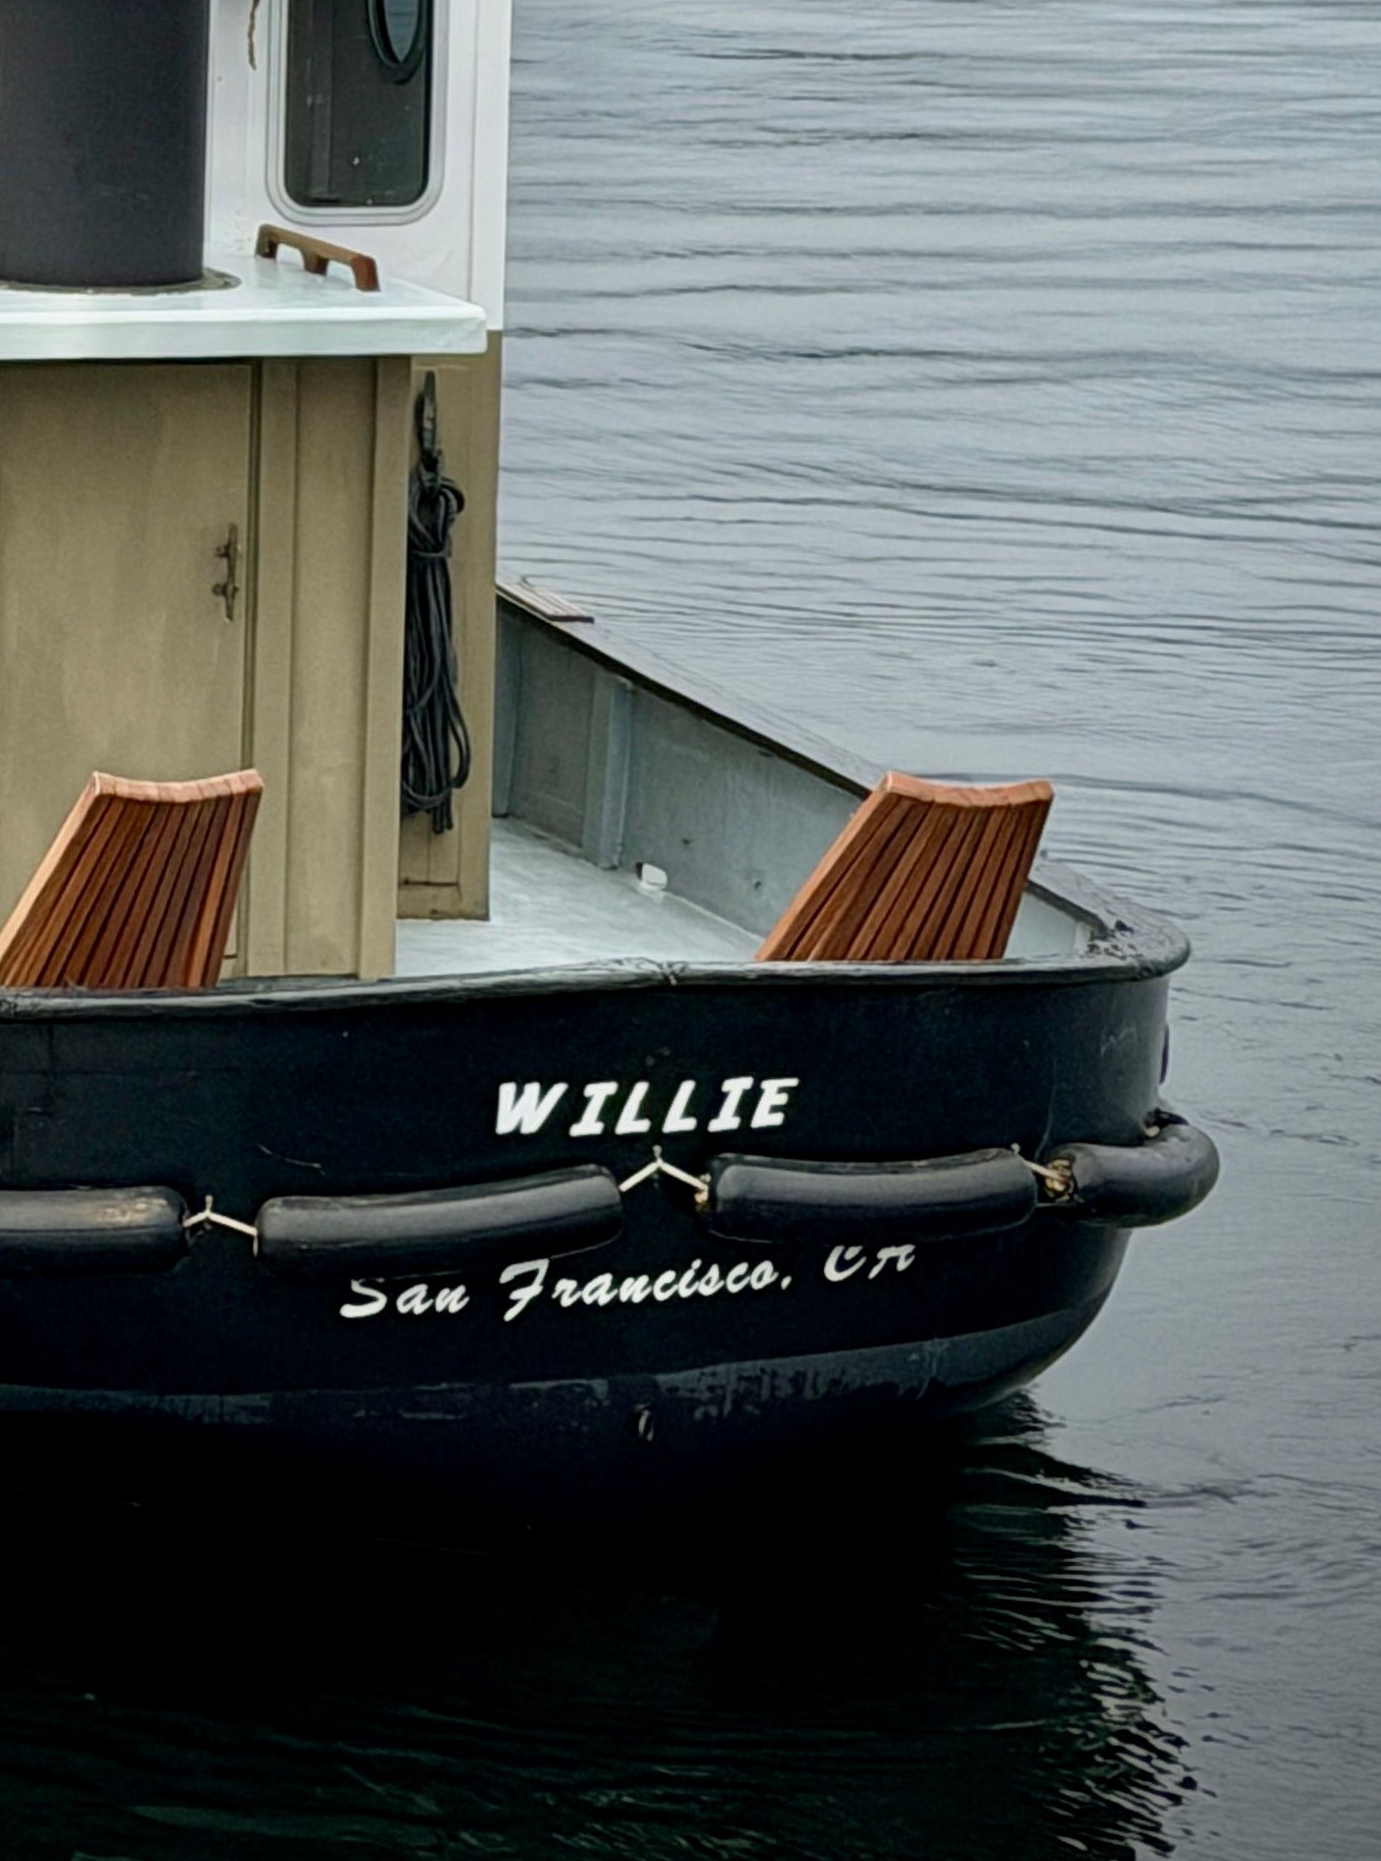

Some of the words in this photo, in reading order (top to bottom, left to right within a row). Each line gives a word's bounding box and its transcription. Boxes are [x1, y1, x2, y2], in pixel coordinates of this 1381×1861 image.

[495, 1076, 799, 1137] WILLIE
[340, 1278, 470, 1318] San
[499, 1258, 792, 1322] Francisco,
